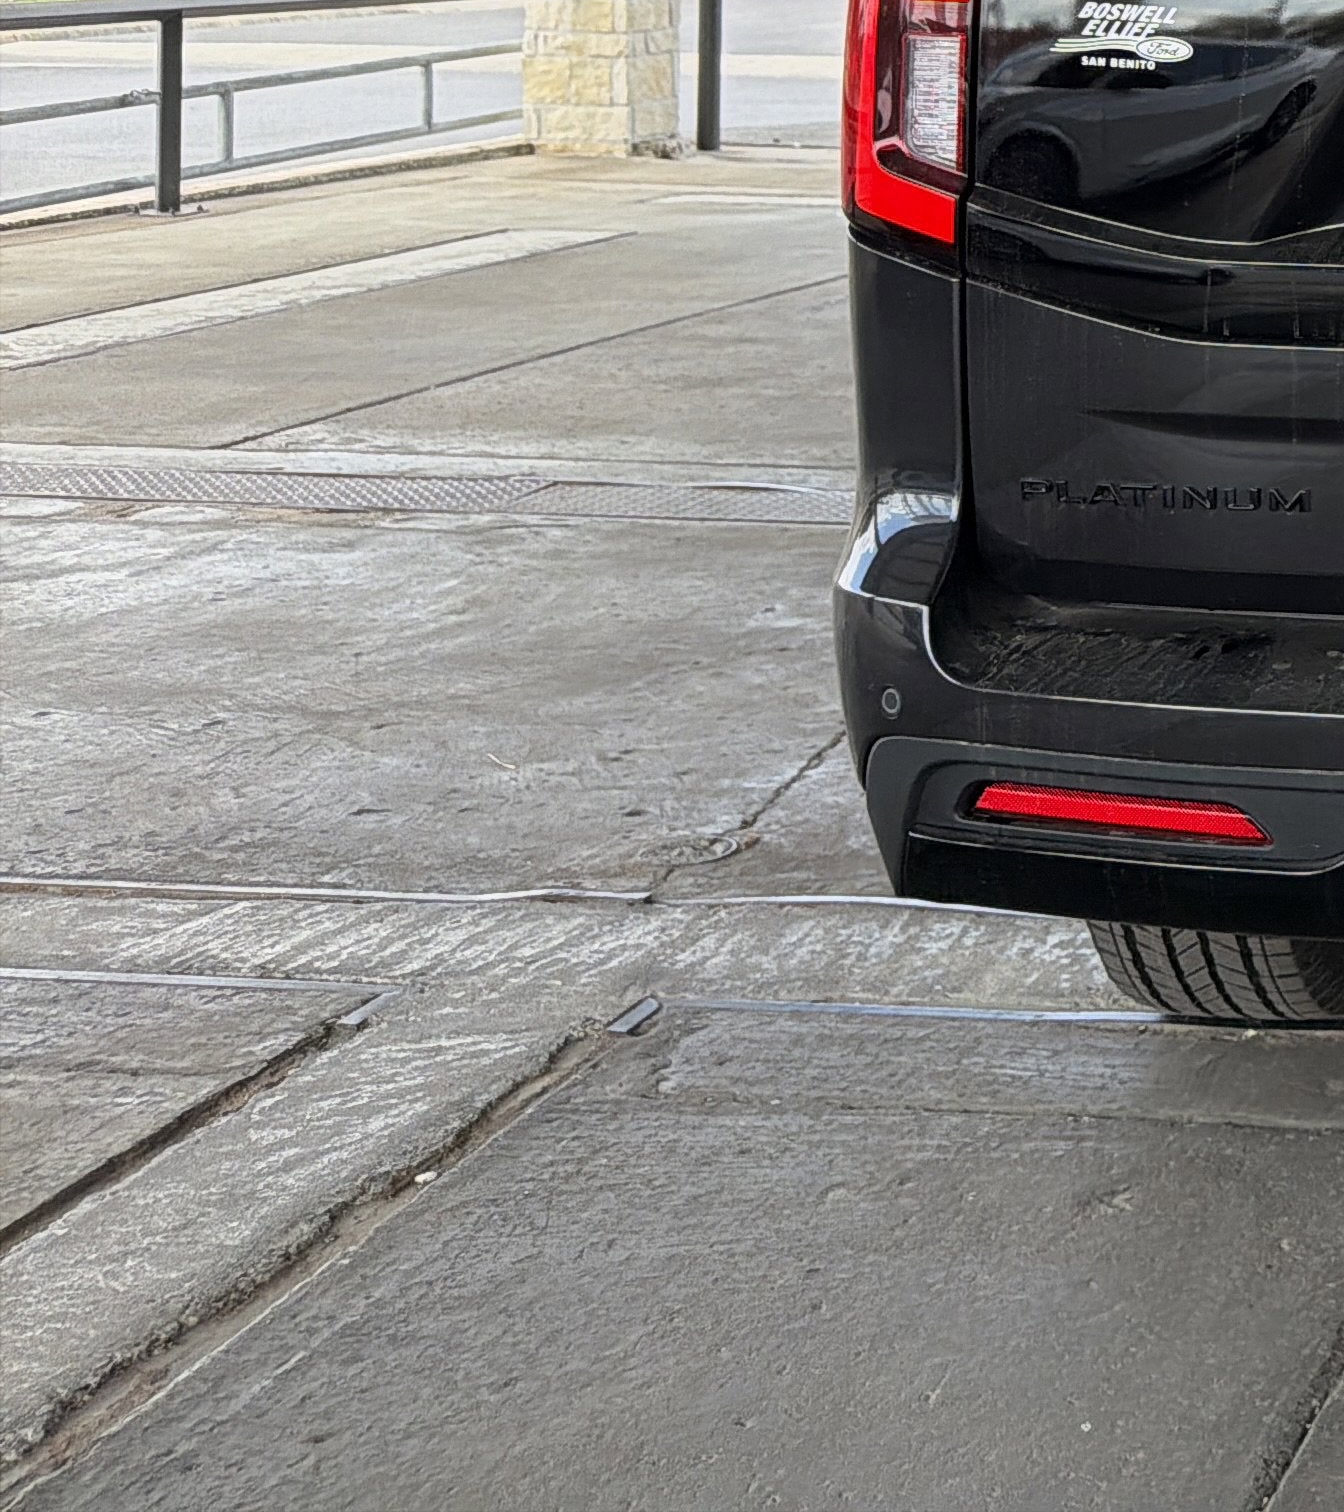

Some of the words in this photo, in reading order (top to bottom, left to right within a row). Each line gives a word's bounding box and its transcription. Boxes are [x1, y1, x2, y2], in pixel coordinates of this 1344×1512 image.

[1077, 1, 1178, 25] BOSWELL
[1080, 19, 1160, 40] ELLIFF
[1081, 55, 1106, 67] SAN
[1109, 57, 1157, 71] BENITO
[1020, 477, 1312, 513] PLATINUM
